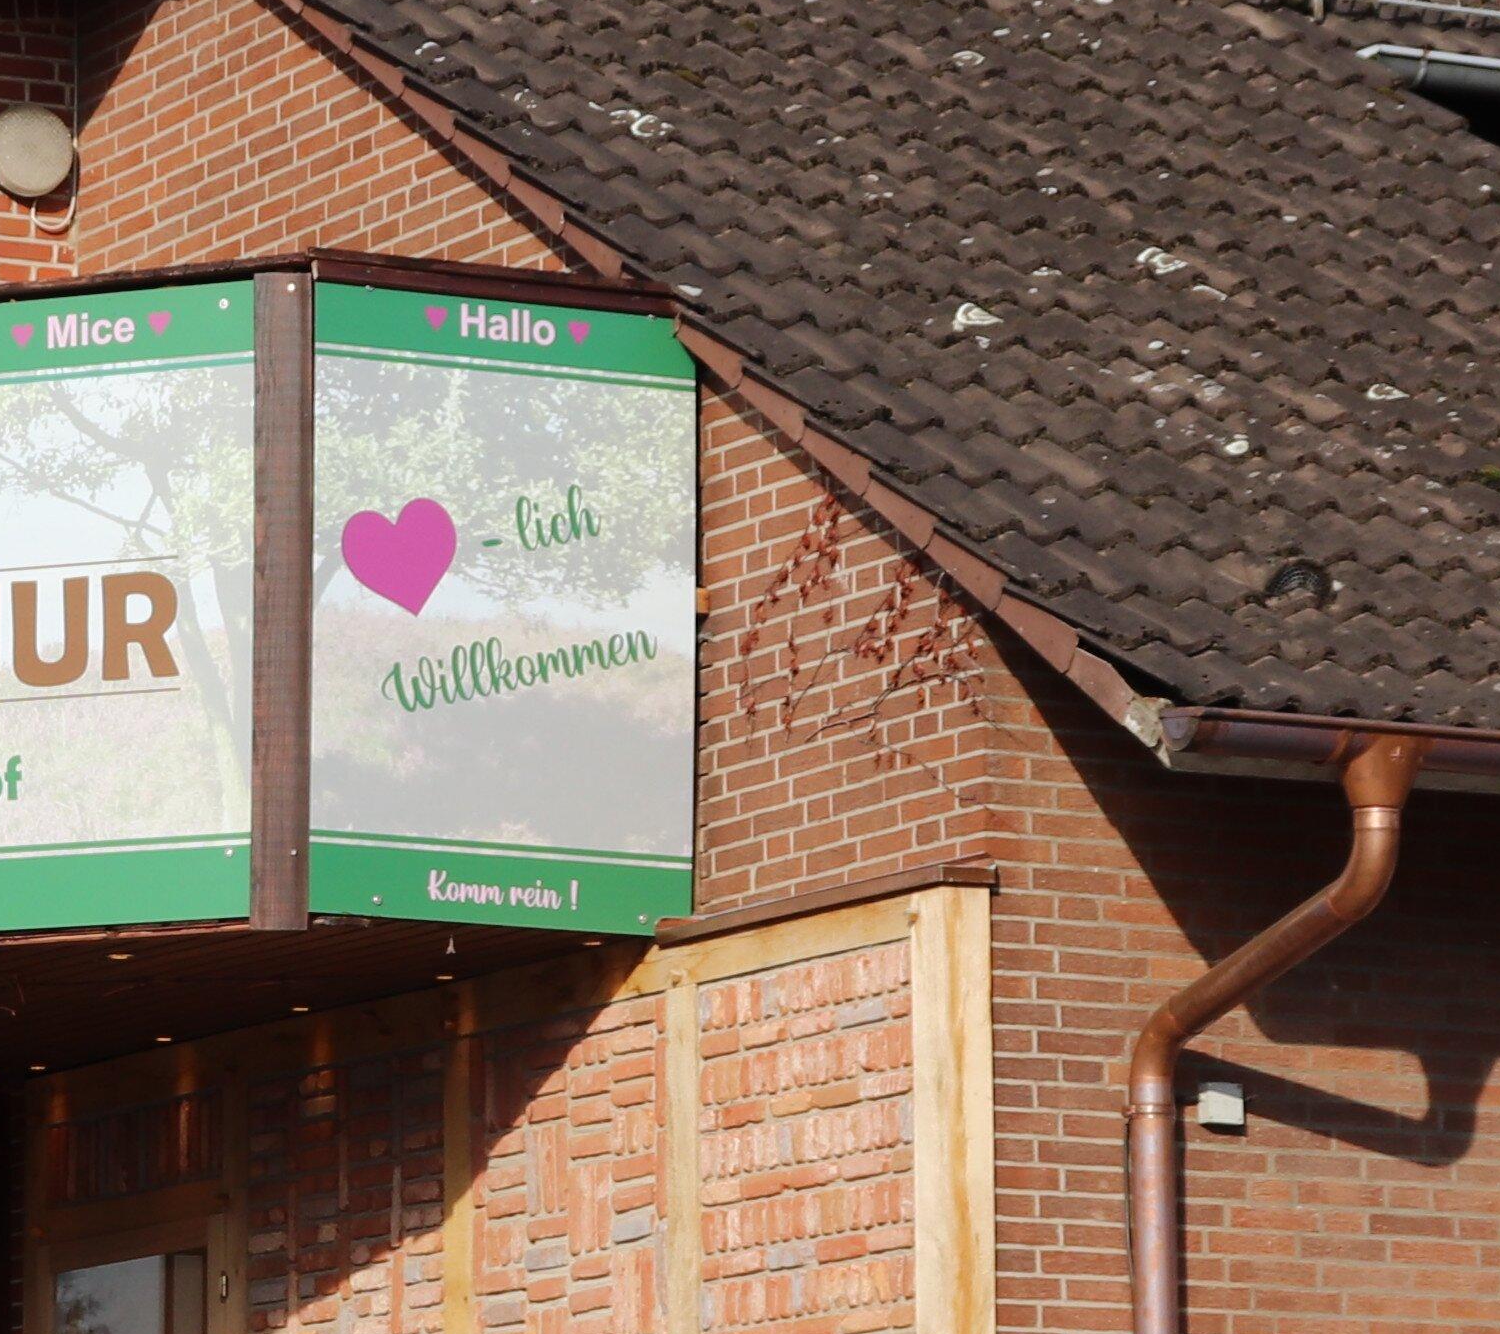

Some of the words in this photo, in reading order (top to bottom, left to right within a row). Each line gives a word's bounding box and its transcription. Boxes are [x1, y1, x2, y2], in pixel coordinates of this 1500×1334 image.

[46, 312, 136, 349] Mice
[460, 302, 557, 346] Hallo
[381, 629, 658, 713] Willkommen
[427, 868, 506, 907] Komm
[509, 879, 563, 911] rein
